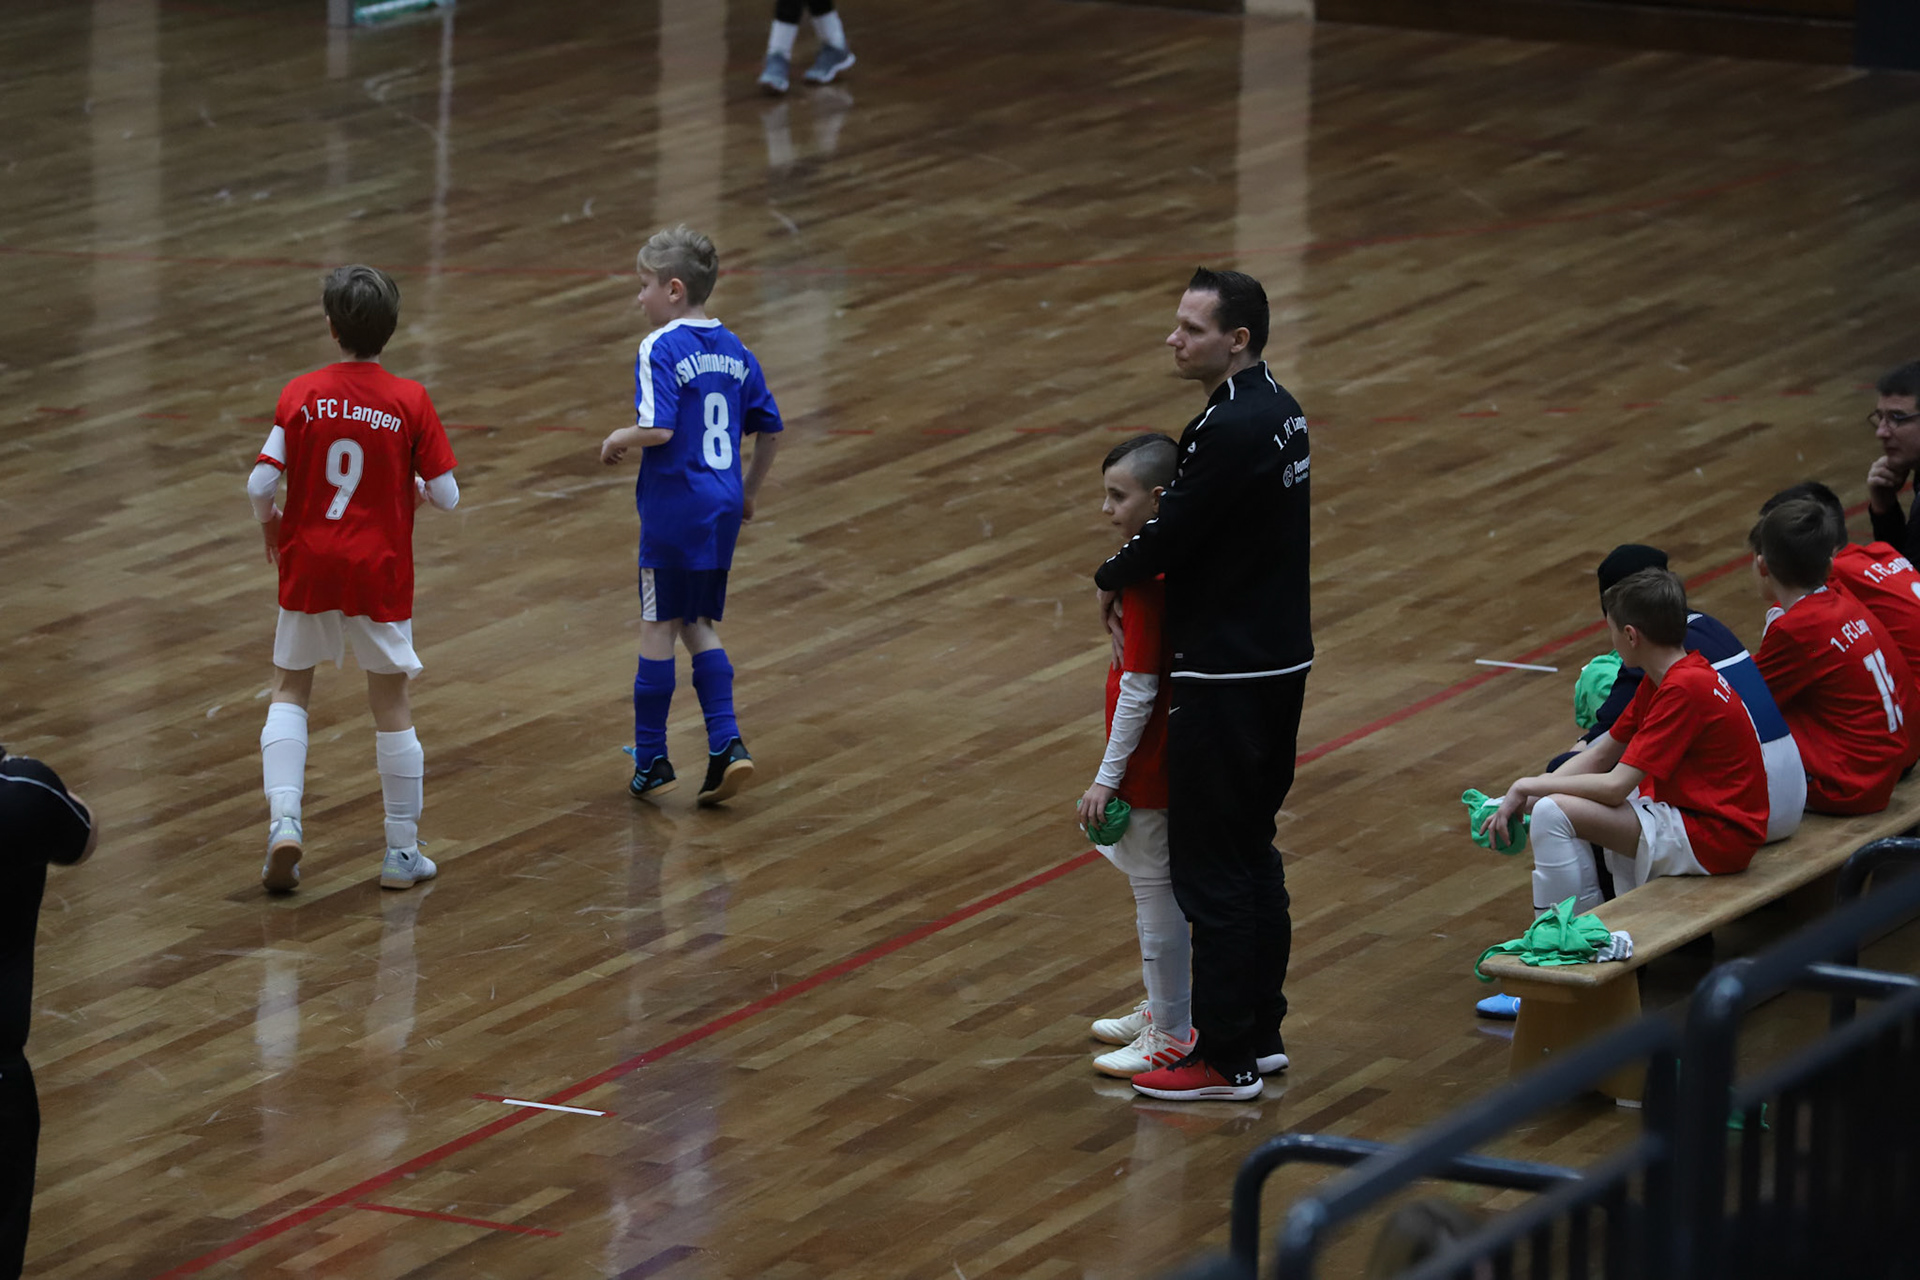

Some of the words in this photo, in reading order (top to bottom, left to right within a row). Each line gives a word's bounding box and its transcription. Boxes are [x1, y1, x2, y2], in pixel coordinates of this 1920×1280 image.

[301, 405, 314, 424] 1.
[317, 398, 338, 419] FC
[343, 399, 402, 433] Langen
[702, 392, 733, 470] 8
[1273, 433, 1287, 450] 1.
[1283, 419, 1293, 439] FC
[325, 438, 364, 520] 9
[1864, 569, 1883, 583] 1.
[1830, 637, 1850, 653] 1.
[1841, 622, 1859, 644] FC
[1713, 688, 1730, 703] 1.
